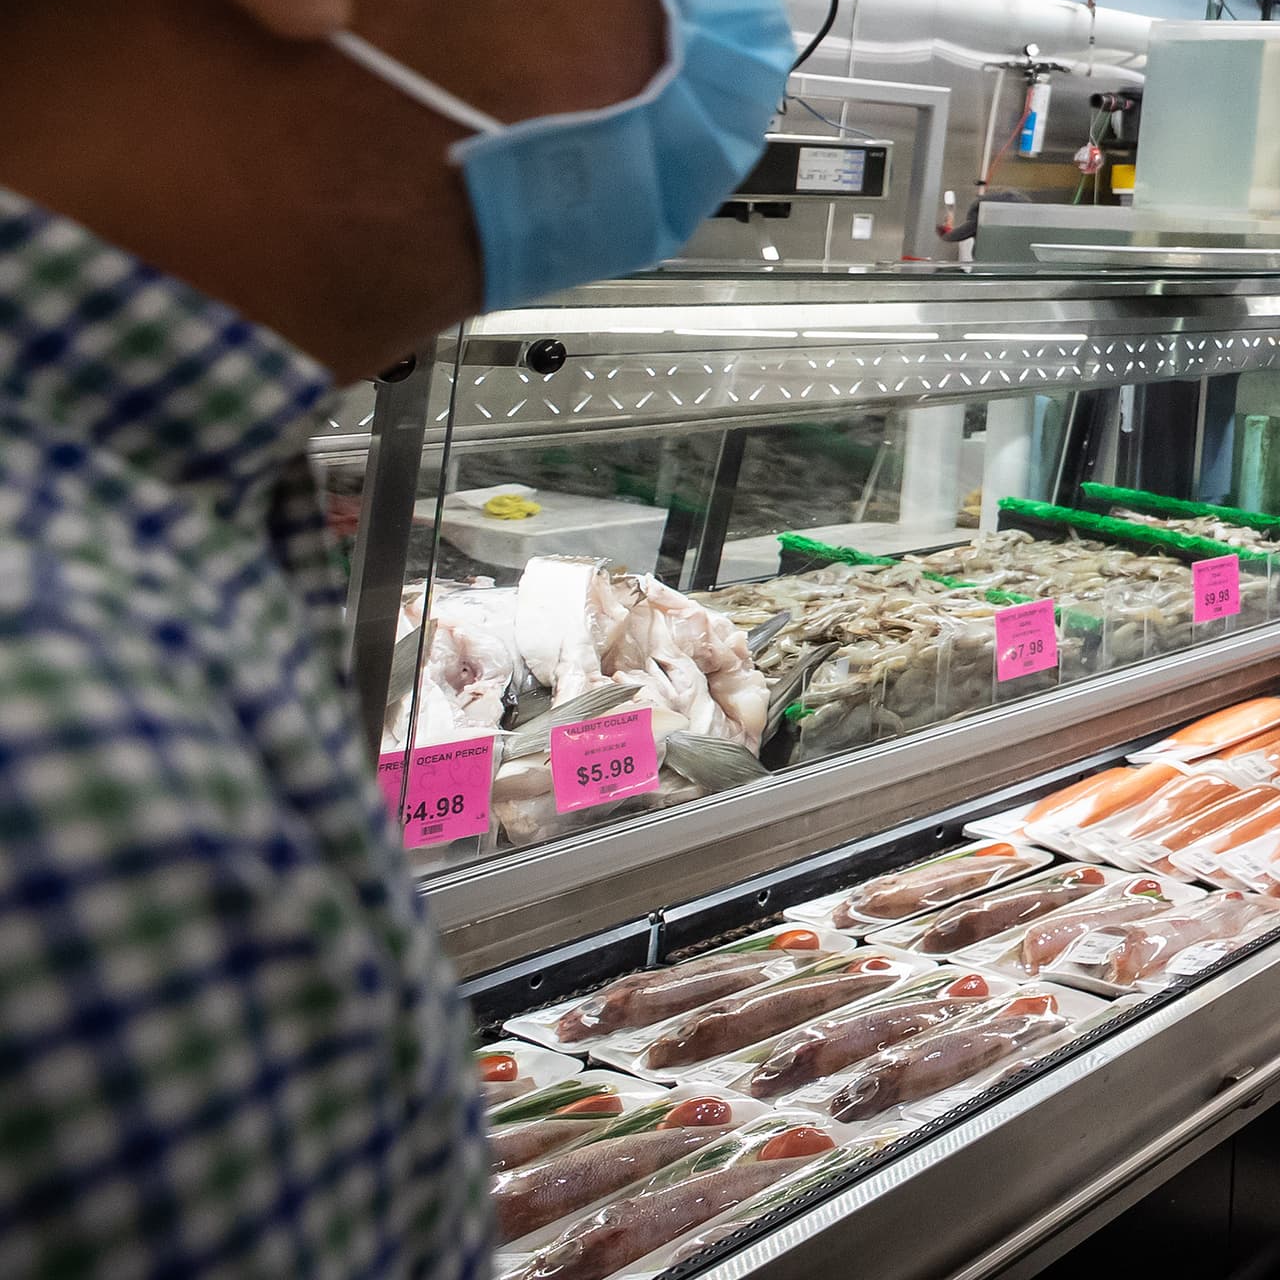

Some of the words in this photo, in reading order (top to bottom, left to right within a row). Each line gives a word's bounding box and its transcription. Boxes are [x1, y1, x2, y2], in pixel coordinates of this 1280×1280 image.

[604, 714, 638, 729] COLLAR
[379, 761, 406, 772] FRES
[416, 752, 453, 766] OCEAN
[455, 746, 489, 759] PERCH
[576, 756, 635, 787] $5.98
